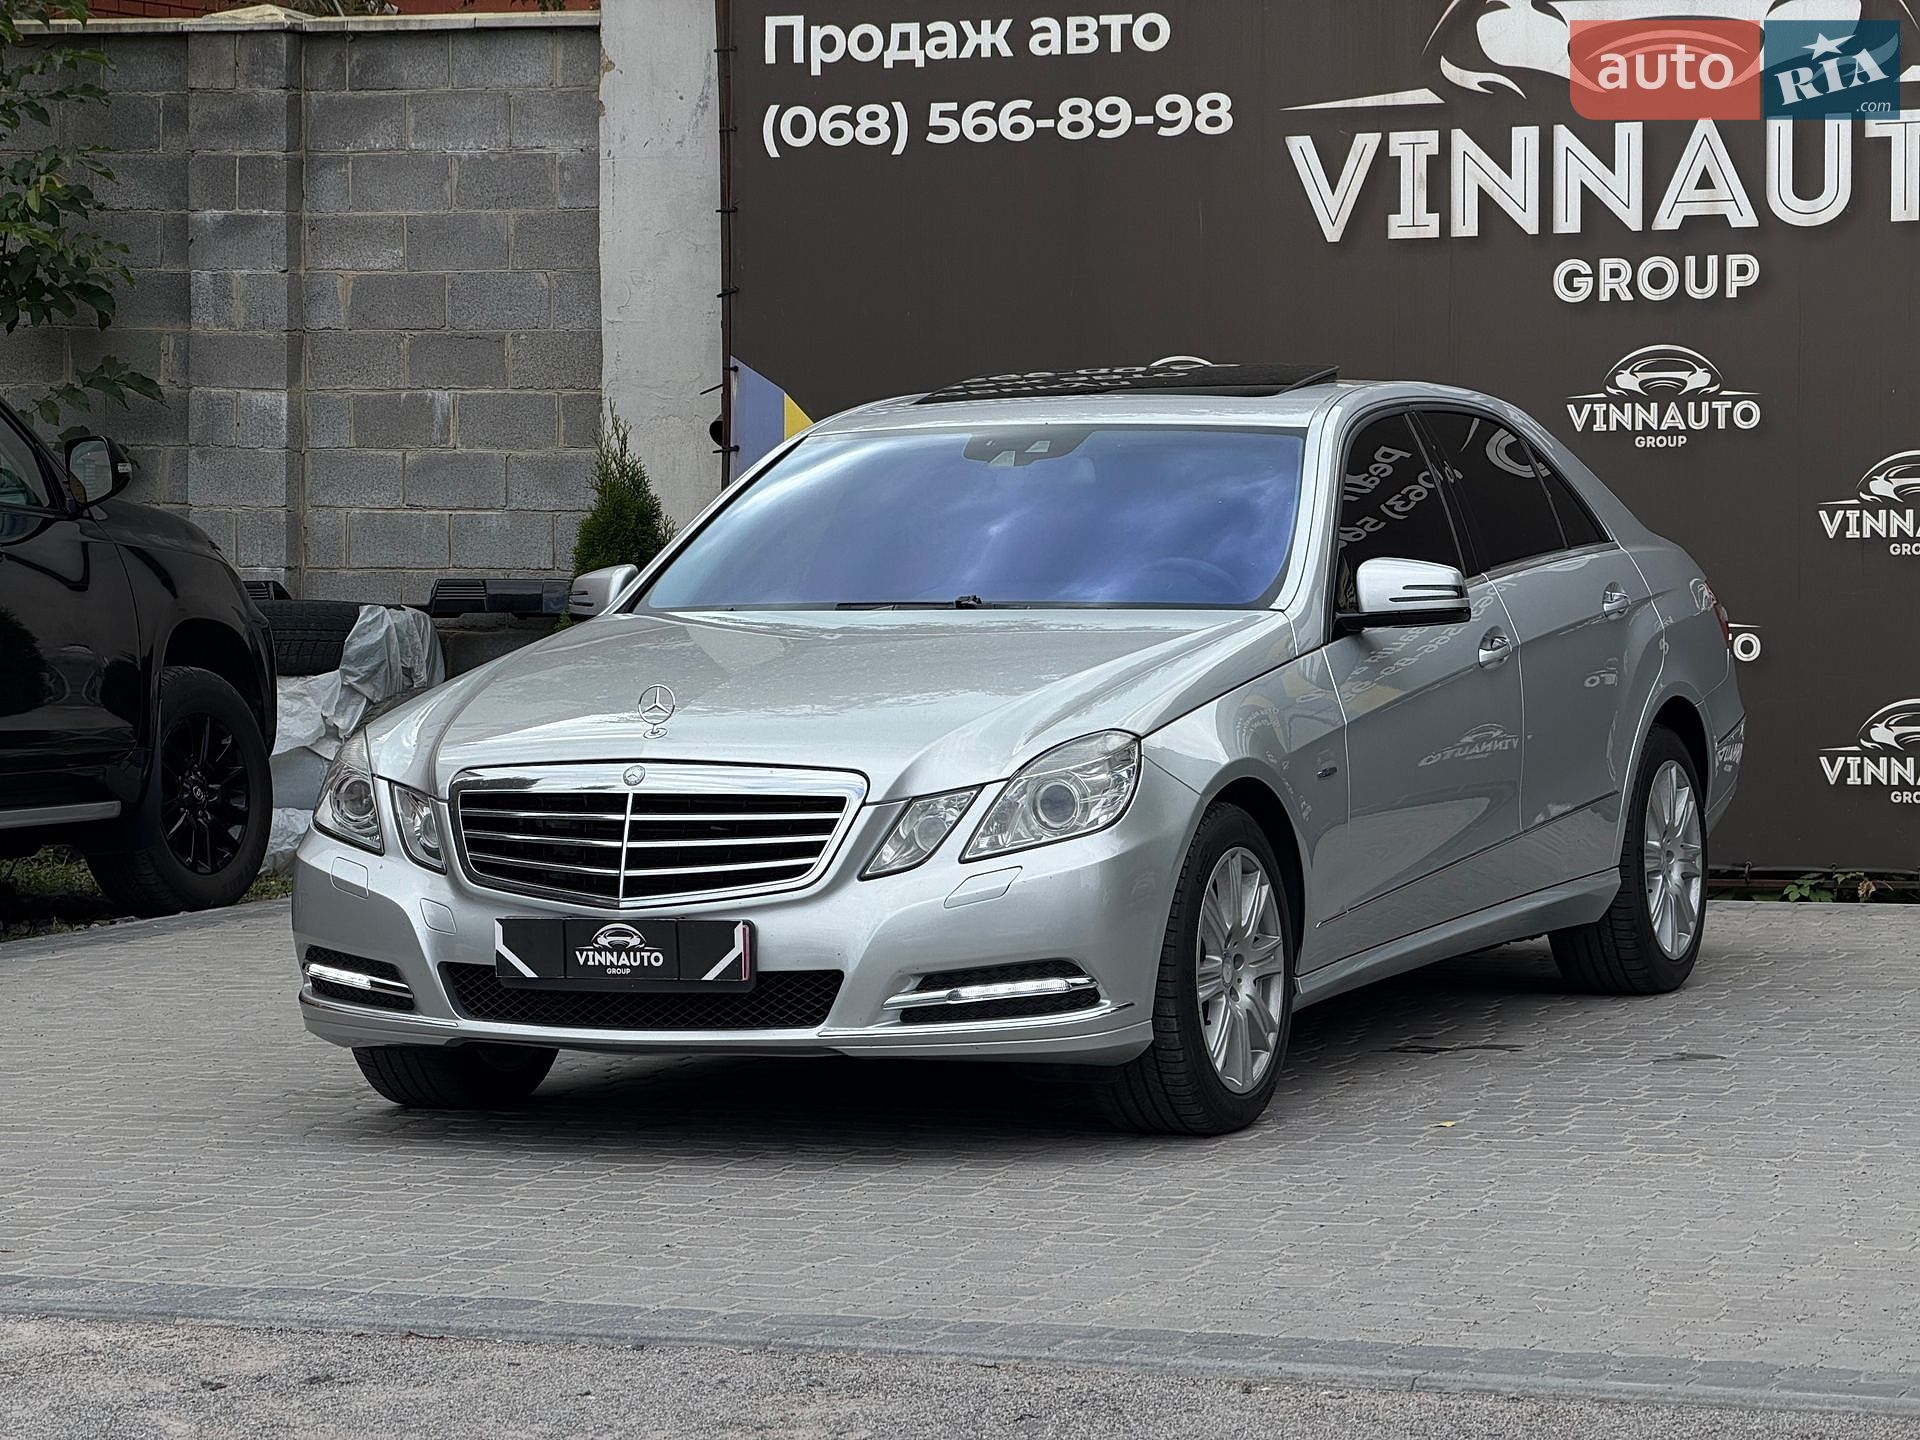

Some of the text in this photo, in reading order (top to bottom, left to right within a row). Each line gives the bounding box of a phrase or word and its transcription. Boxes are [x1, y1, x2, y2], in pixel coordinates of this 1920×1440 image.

[765, 12, 1171, 76] Продаж авто
[762, 92, 1234, 158] (068) 566-89-98
[1552, 253, 1760, 303] GROUP
[1566, 400, 1761, 432] VINNAUTO
[1634, 435, 1688, 448] GROUP
[575, 950, 664, 967] VINNAUTO
[606, 967, 631, 975] GROUP
